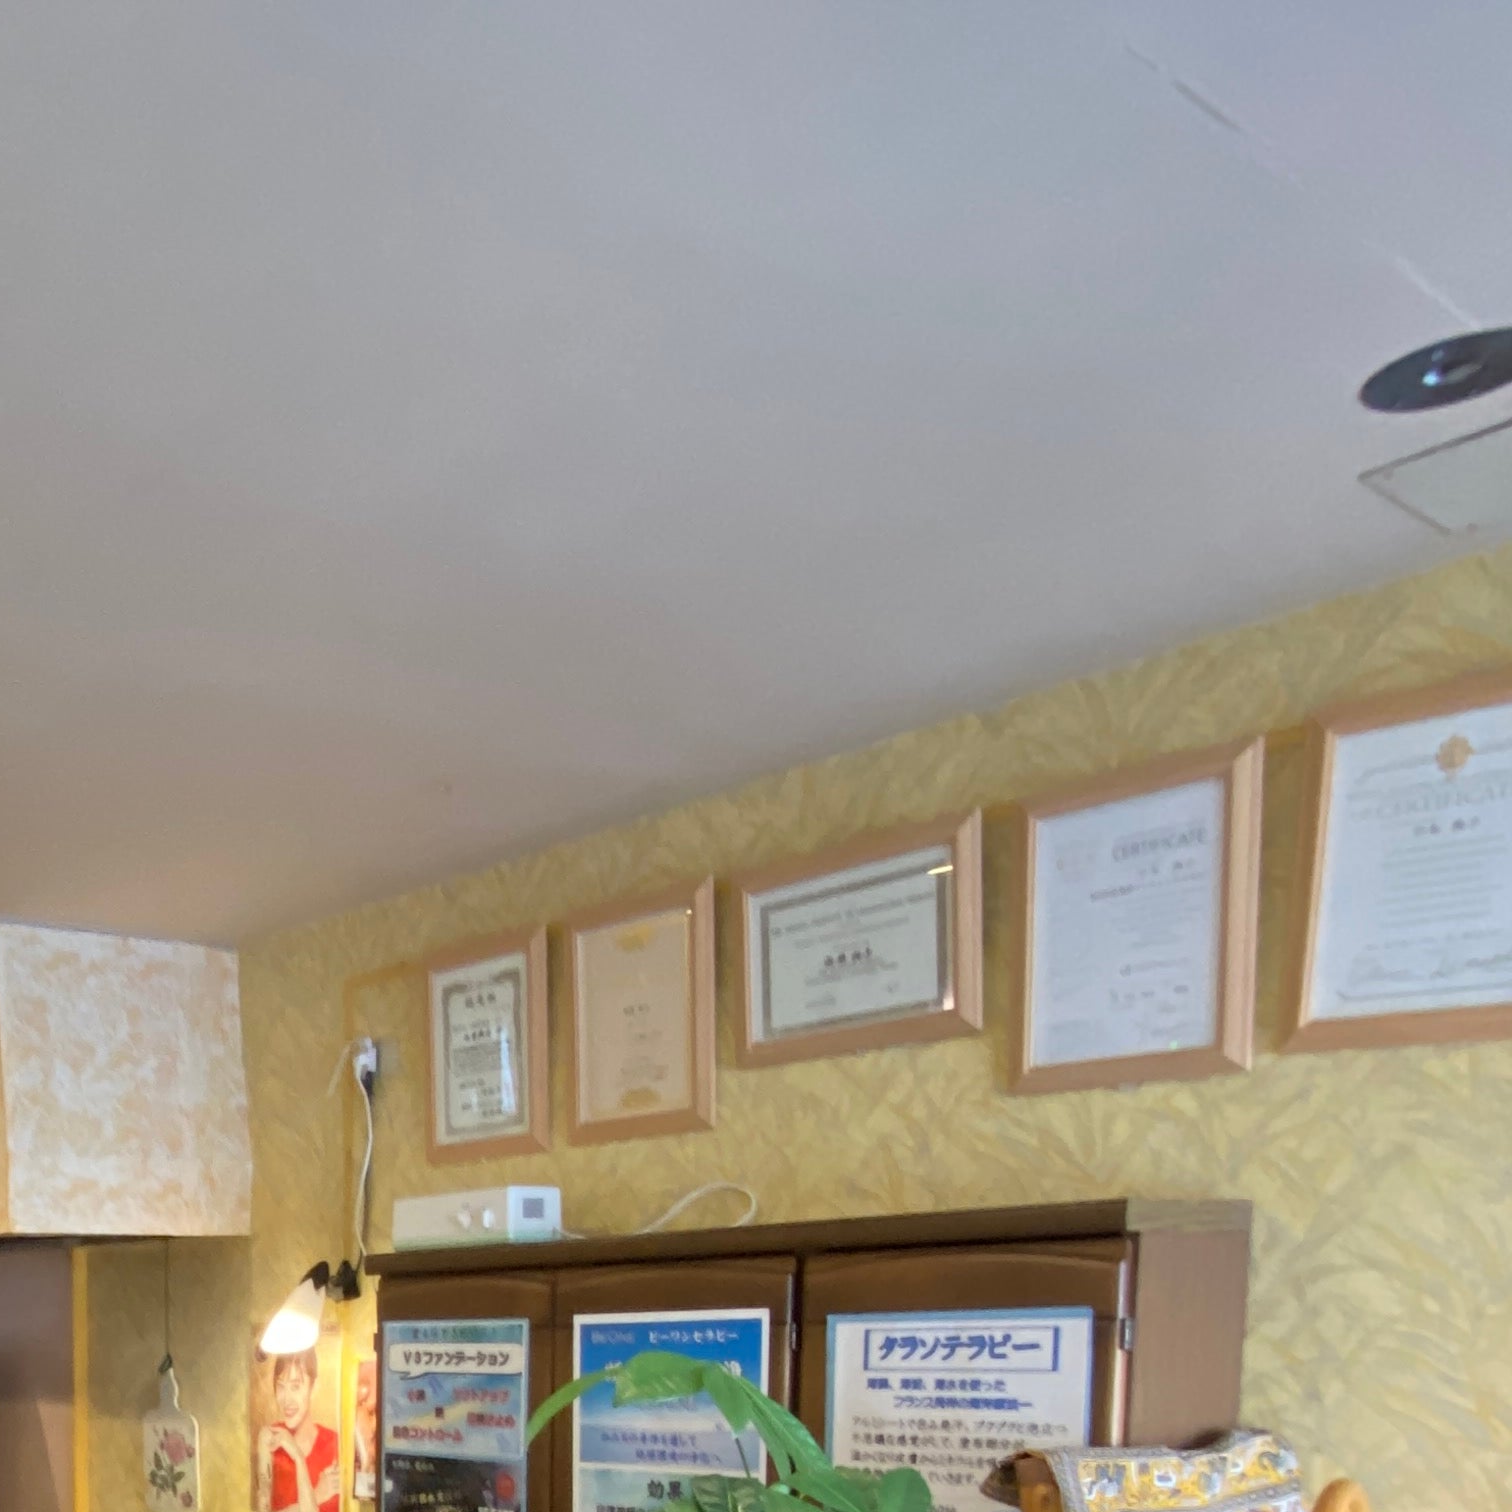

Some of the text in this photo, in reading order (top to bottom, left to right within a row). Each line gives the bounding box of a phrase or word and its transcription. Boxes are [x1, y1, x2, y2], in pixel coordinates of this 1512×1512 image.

[879, 1333, 1040, 1360] タラソテラピー
[647, 1480, 683, 1500] 効果
